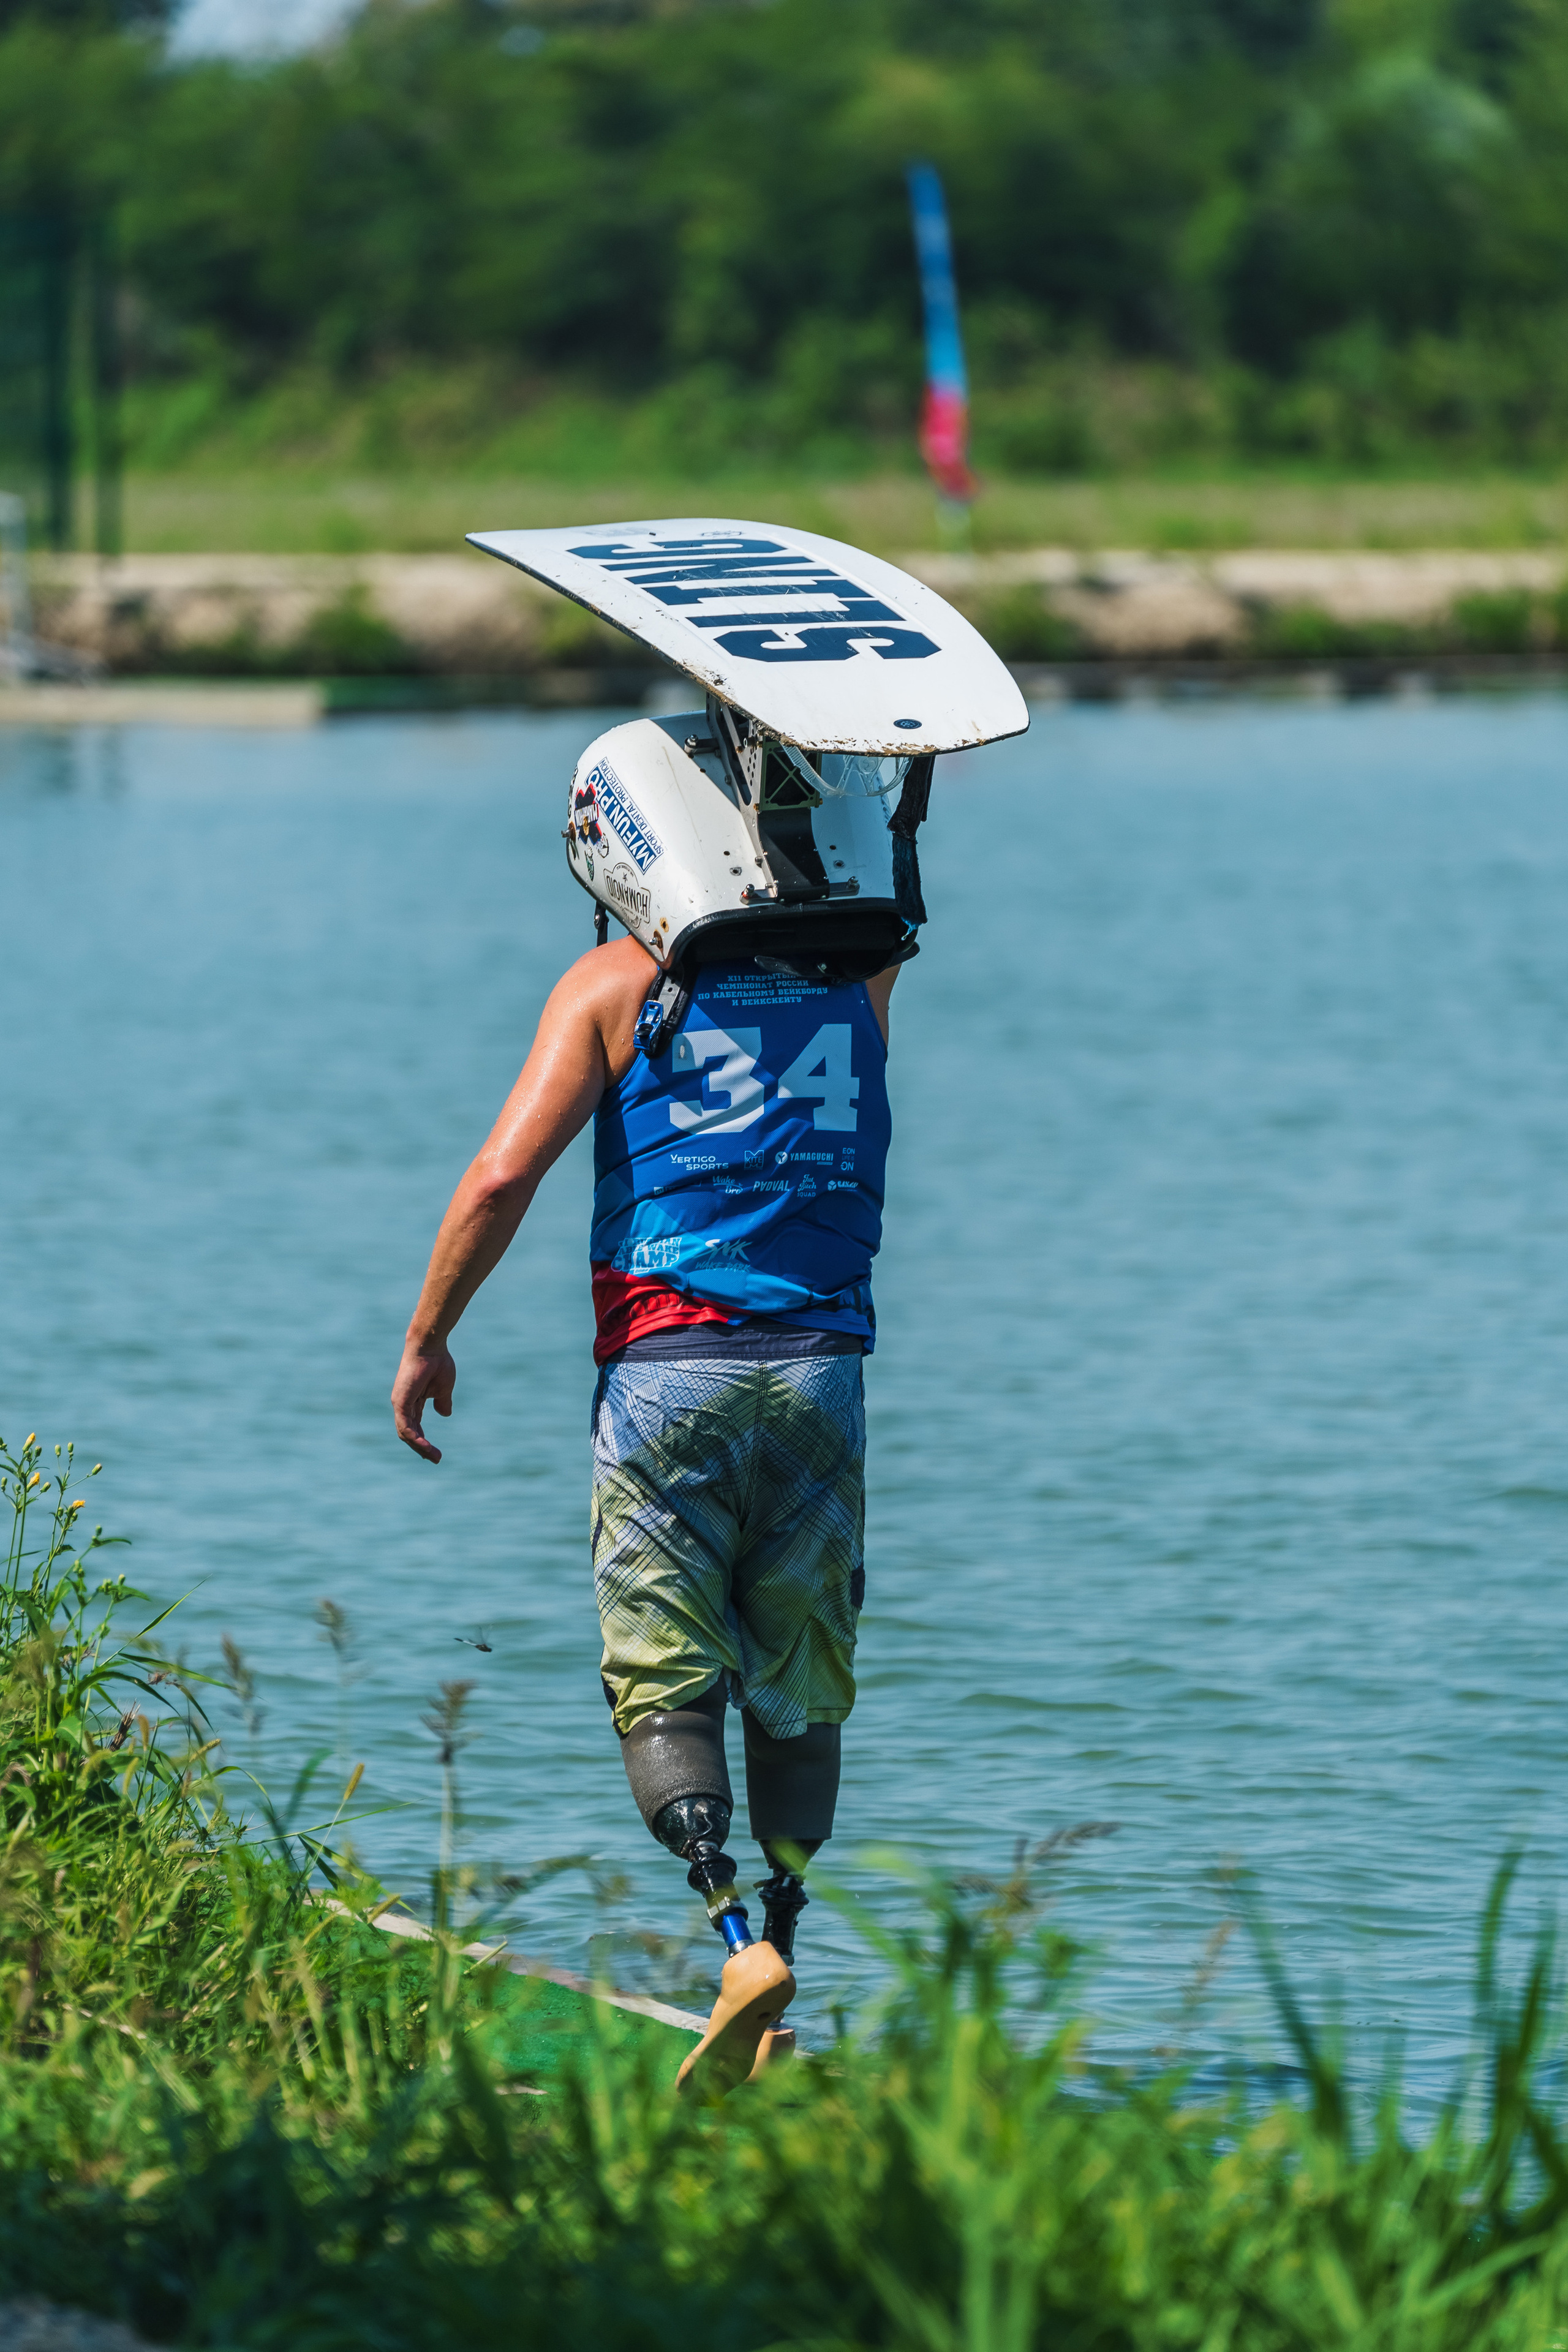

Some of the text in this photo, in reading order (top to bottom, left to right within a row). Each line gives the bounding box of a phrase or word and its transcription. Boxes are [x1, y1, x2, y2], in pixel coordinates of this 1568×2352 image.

[565, 538, 943, 662] SLING
[599, 760, 664, 854] SPORT DENTAL PROTECTION
[606, 875, 648, 918] HUMANOID
[713, 989, 775, 998] КАБЕЛЬНОМУ
[778, 987, 828, 995] ВЕЙКБОРДУ
[741, 995, 802, 1006] ВЕЙКСКЕЙТУ
[669, 1023, 860, 1136] 34
[712, 1175, 735, 1184] Wake
[649, 1243, 679, 1254] WAKE
[612, 1251, 678, 1271] CHAMP
[695, 1261, 723, 1271] WAKE
